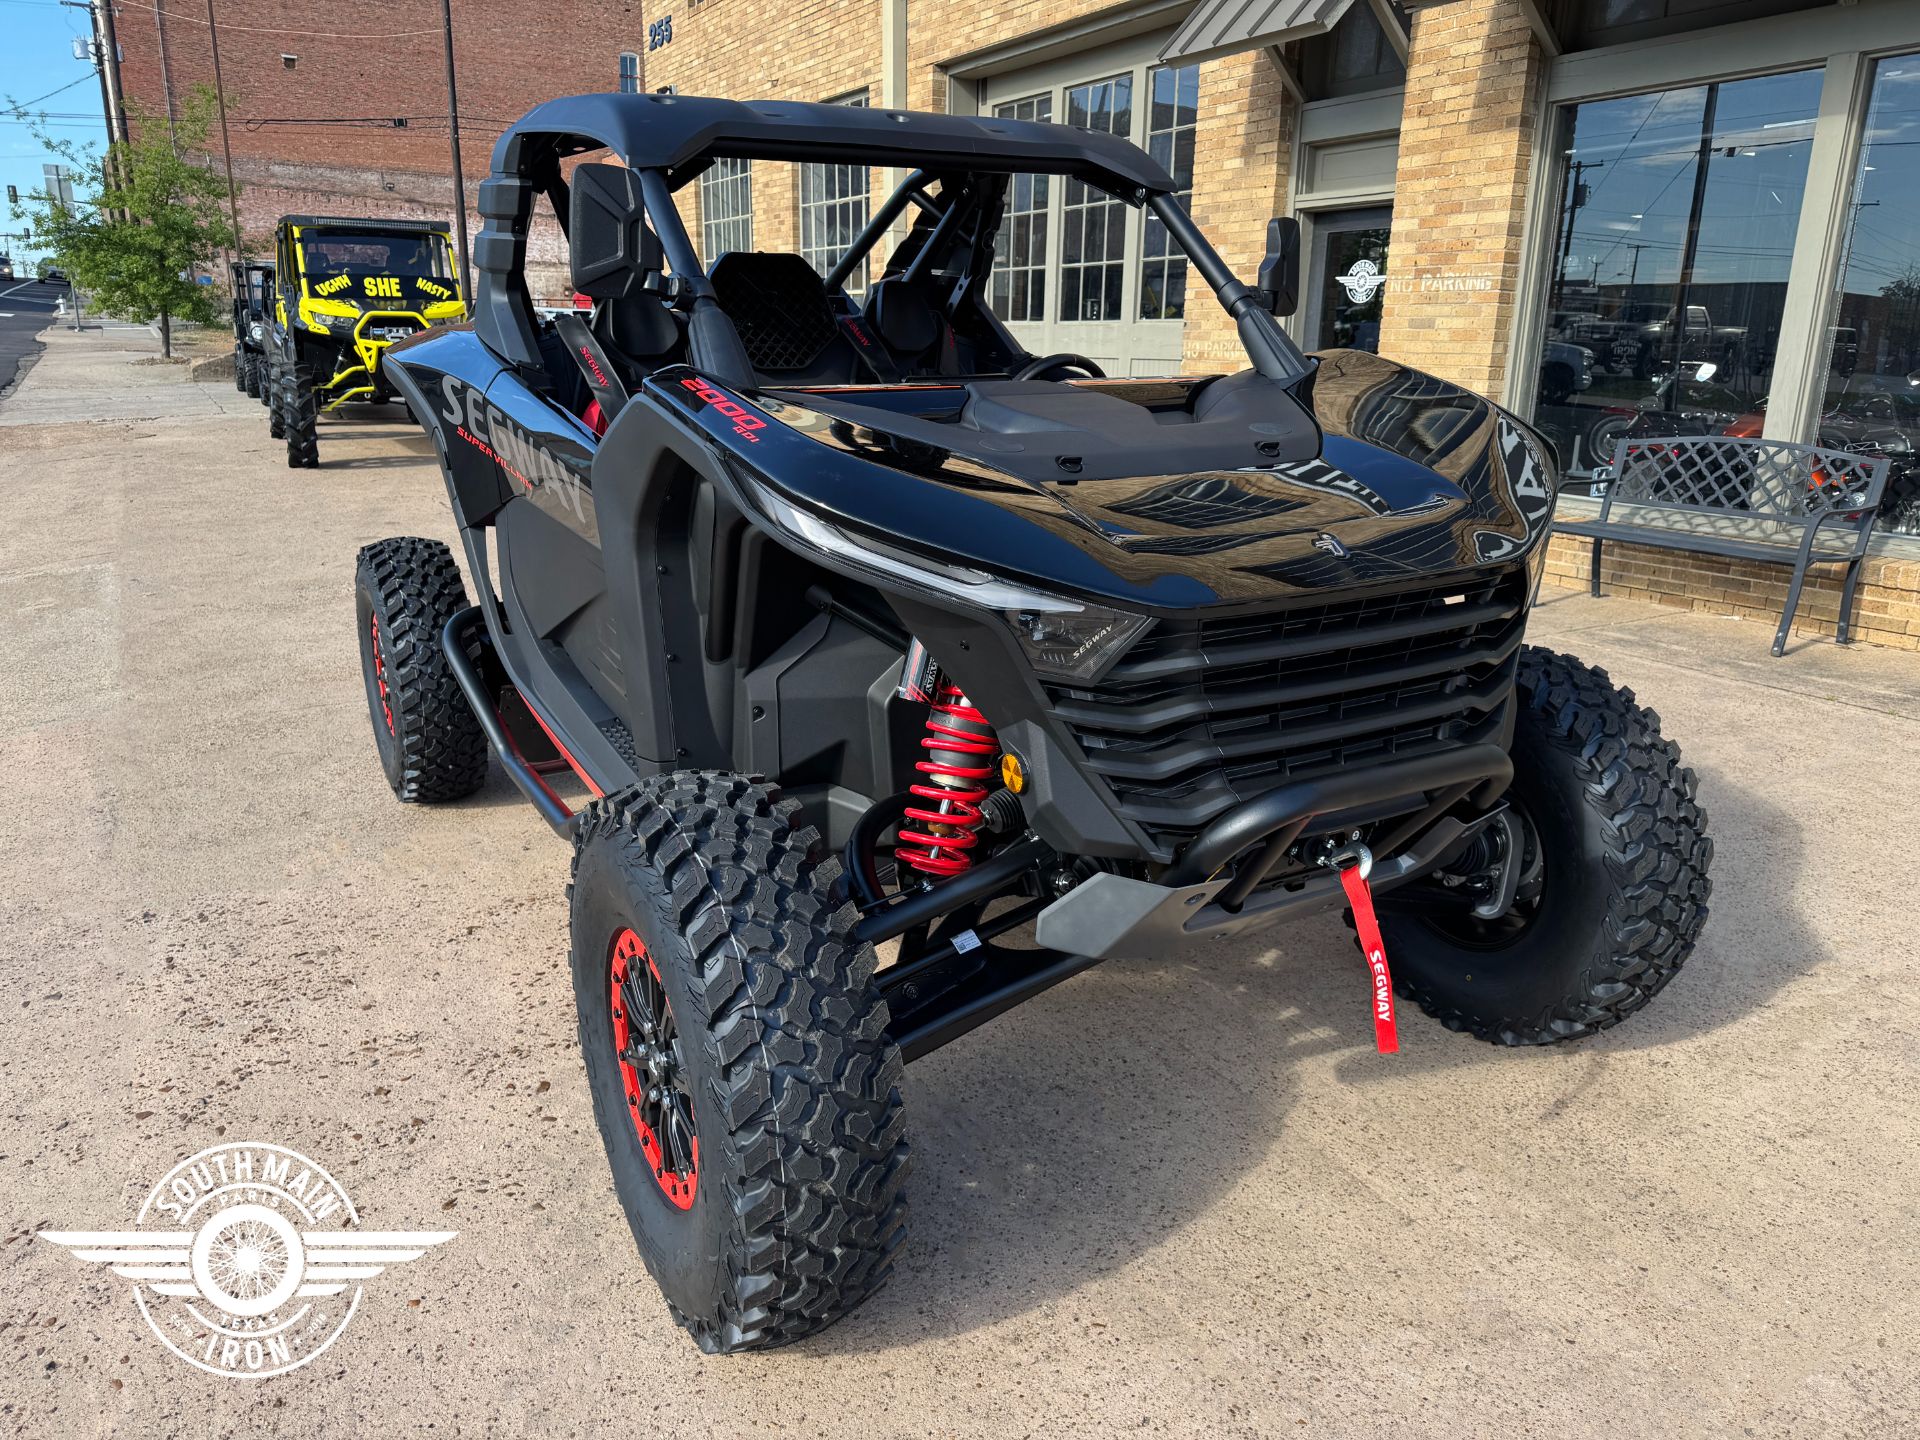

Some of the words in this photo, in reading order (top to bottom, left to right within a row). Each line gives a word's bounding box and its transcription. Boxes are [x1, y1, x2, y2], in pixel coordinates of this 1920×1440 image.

[649, 15, 672, 51] 255
[314, 274, 353, 297] UGHH
[363, 277, 402, 297] SHE
[415, 277, 452, 300] NASTY
[1390, 274, 1413, 292] NO
[1420, 272, 1493, 291] PARKING
[580, 346, 609, 387] SEGWAY
[680, 377, 767, 430] 2000
[442, 374, 586, 524] SEGWAY
[456, 425, 493, 458] SUPER
[733, 426, 760, 443] GDI
[1073, 624, 1112, 660] SEGWAY
[1370, 949, 1391, 1022] SEGWAY
